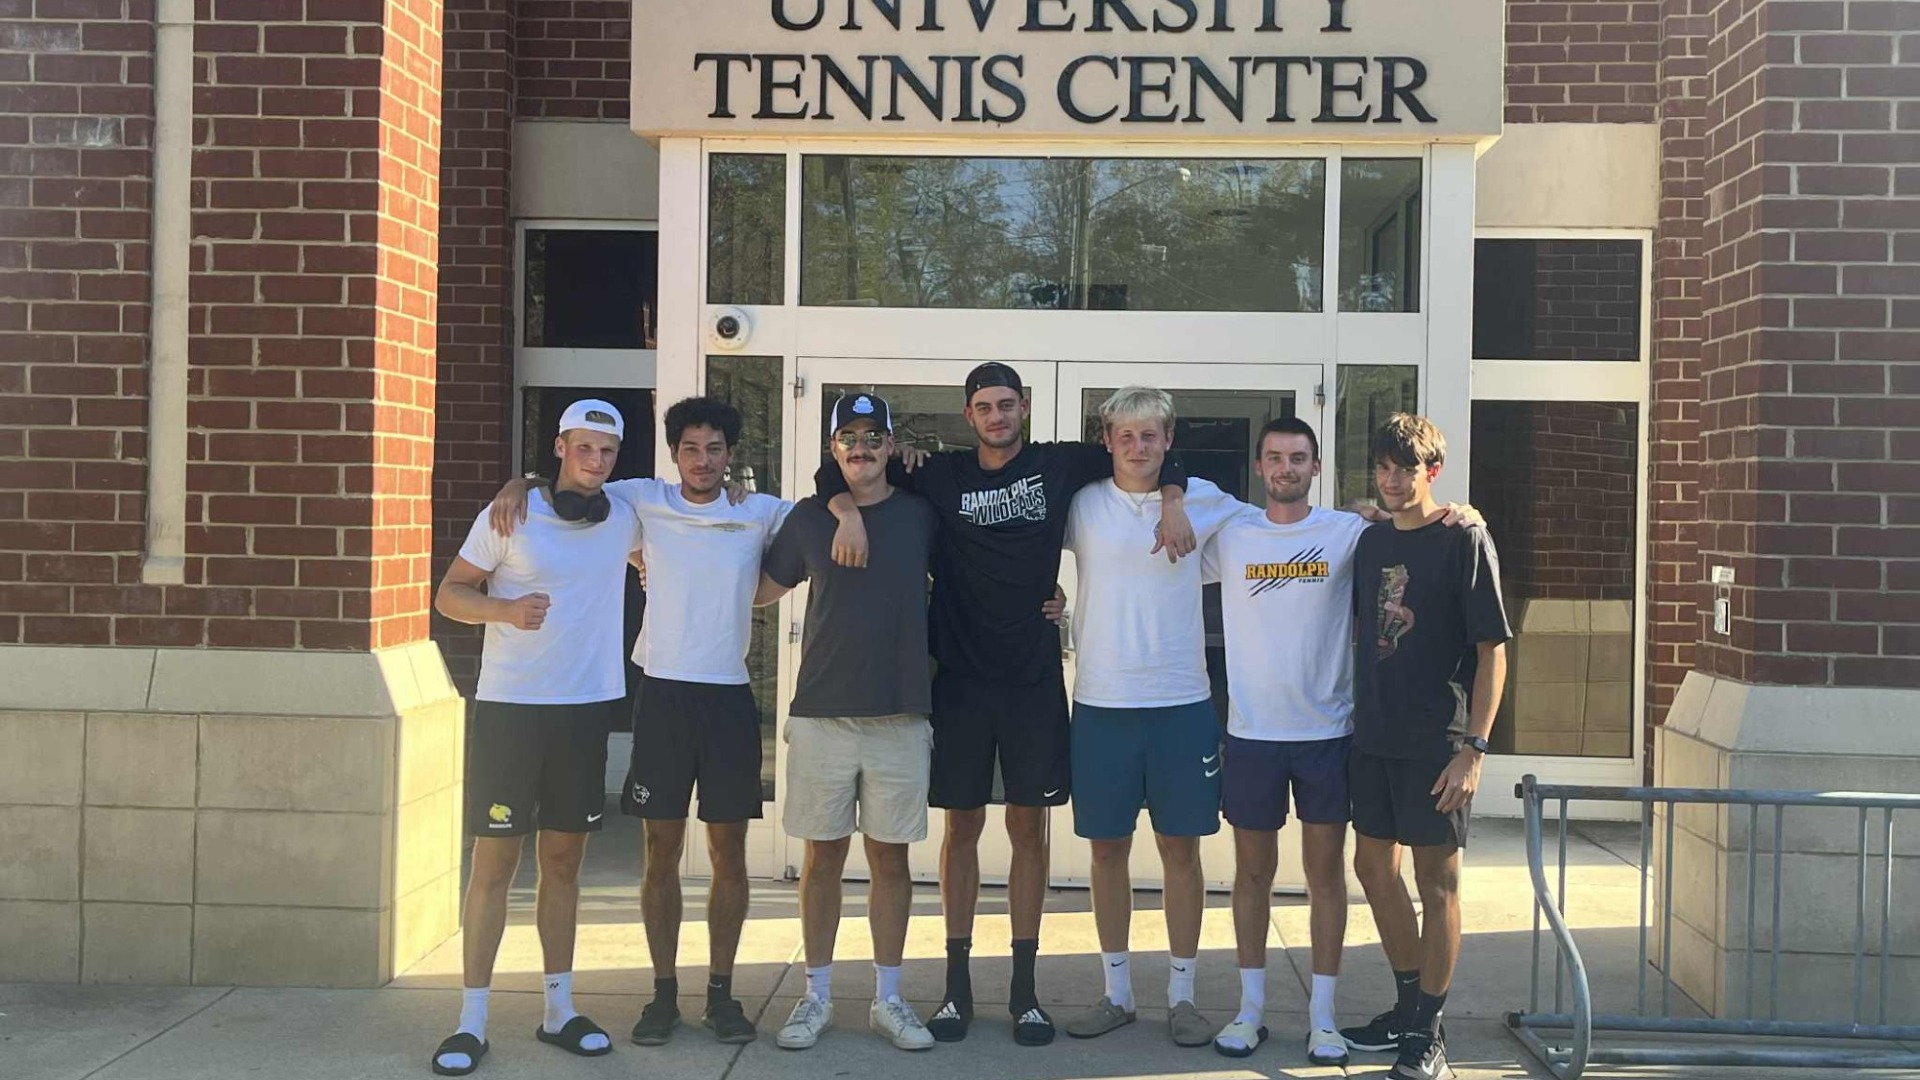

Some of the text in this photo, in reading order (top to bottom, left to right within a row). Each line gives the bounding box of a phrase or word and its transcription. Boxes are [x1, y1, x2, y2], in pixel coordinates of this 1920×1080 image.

[694, 53, 1437, 124] TENNIS CENTER
[972, 487, 1046, 525] WILDCATS
[1246, 562, 1329, 580] RANDOLPH
